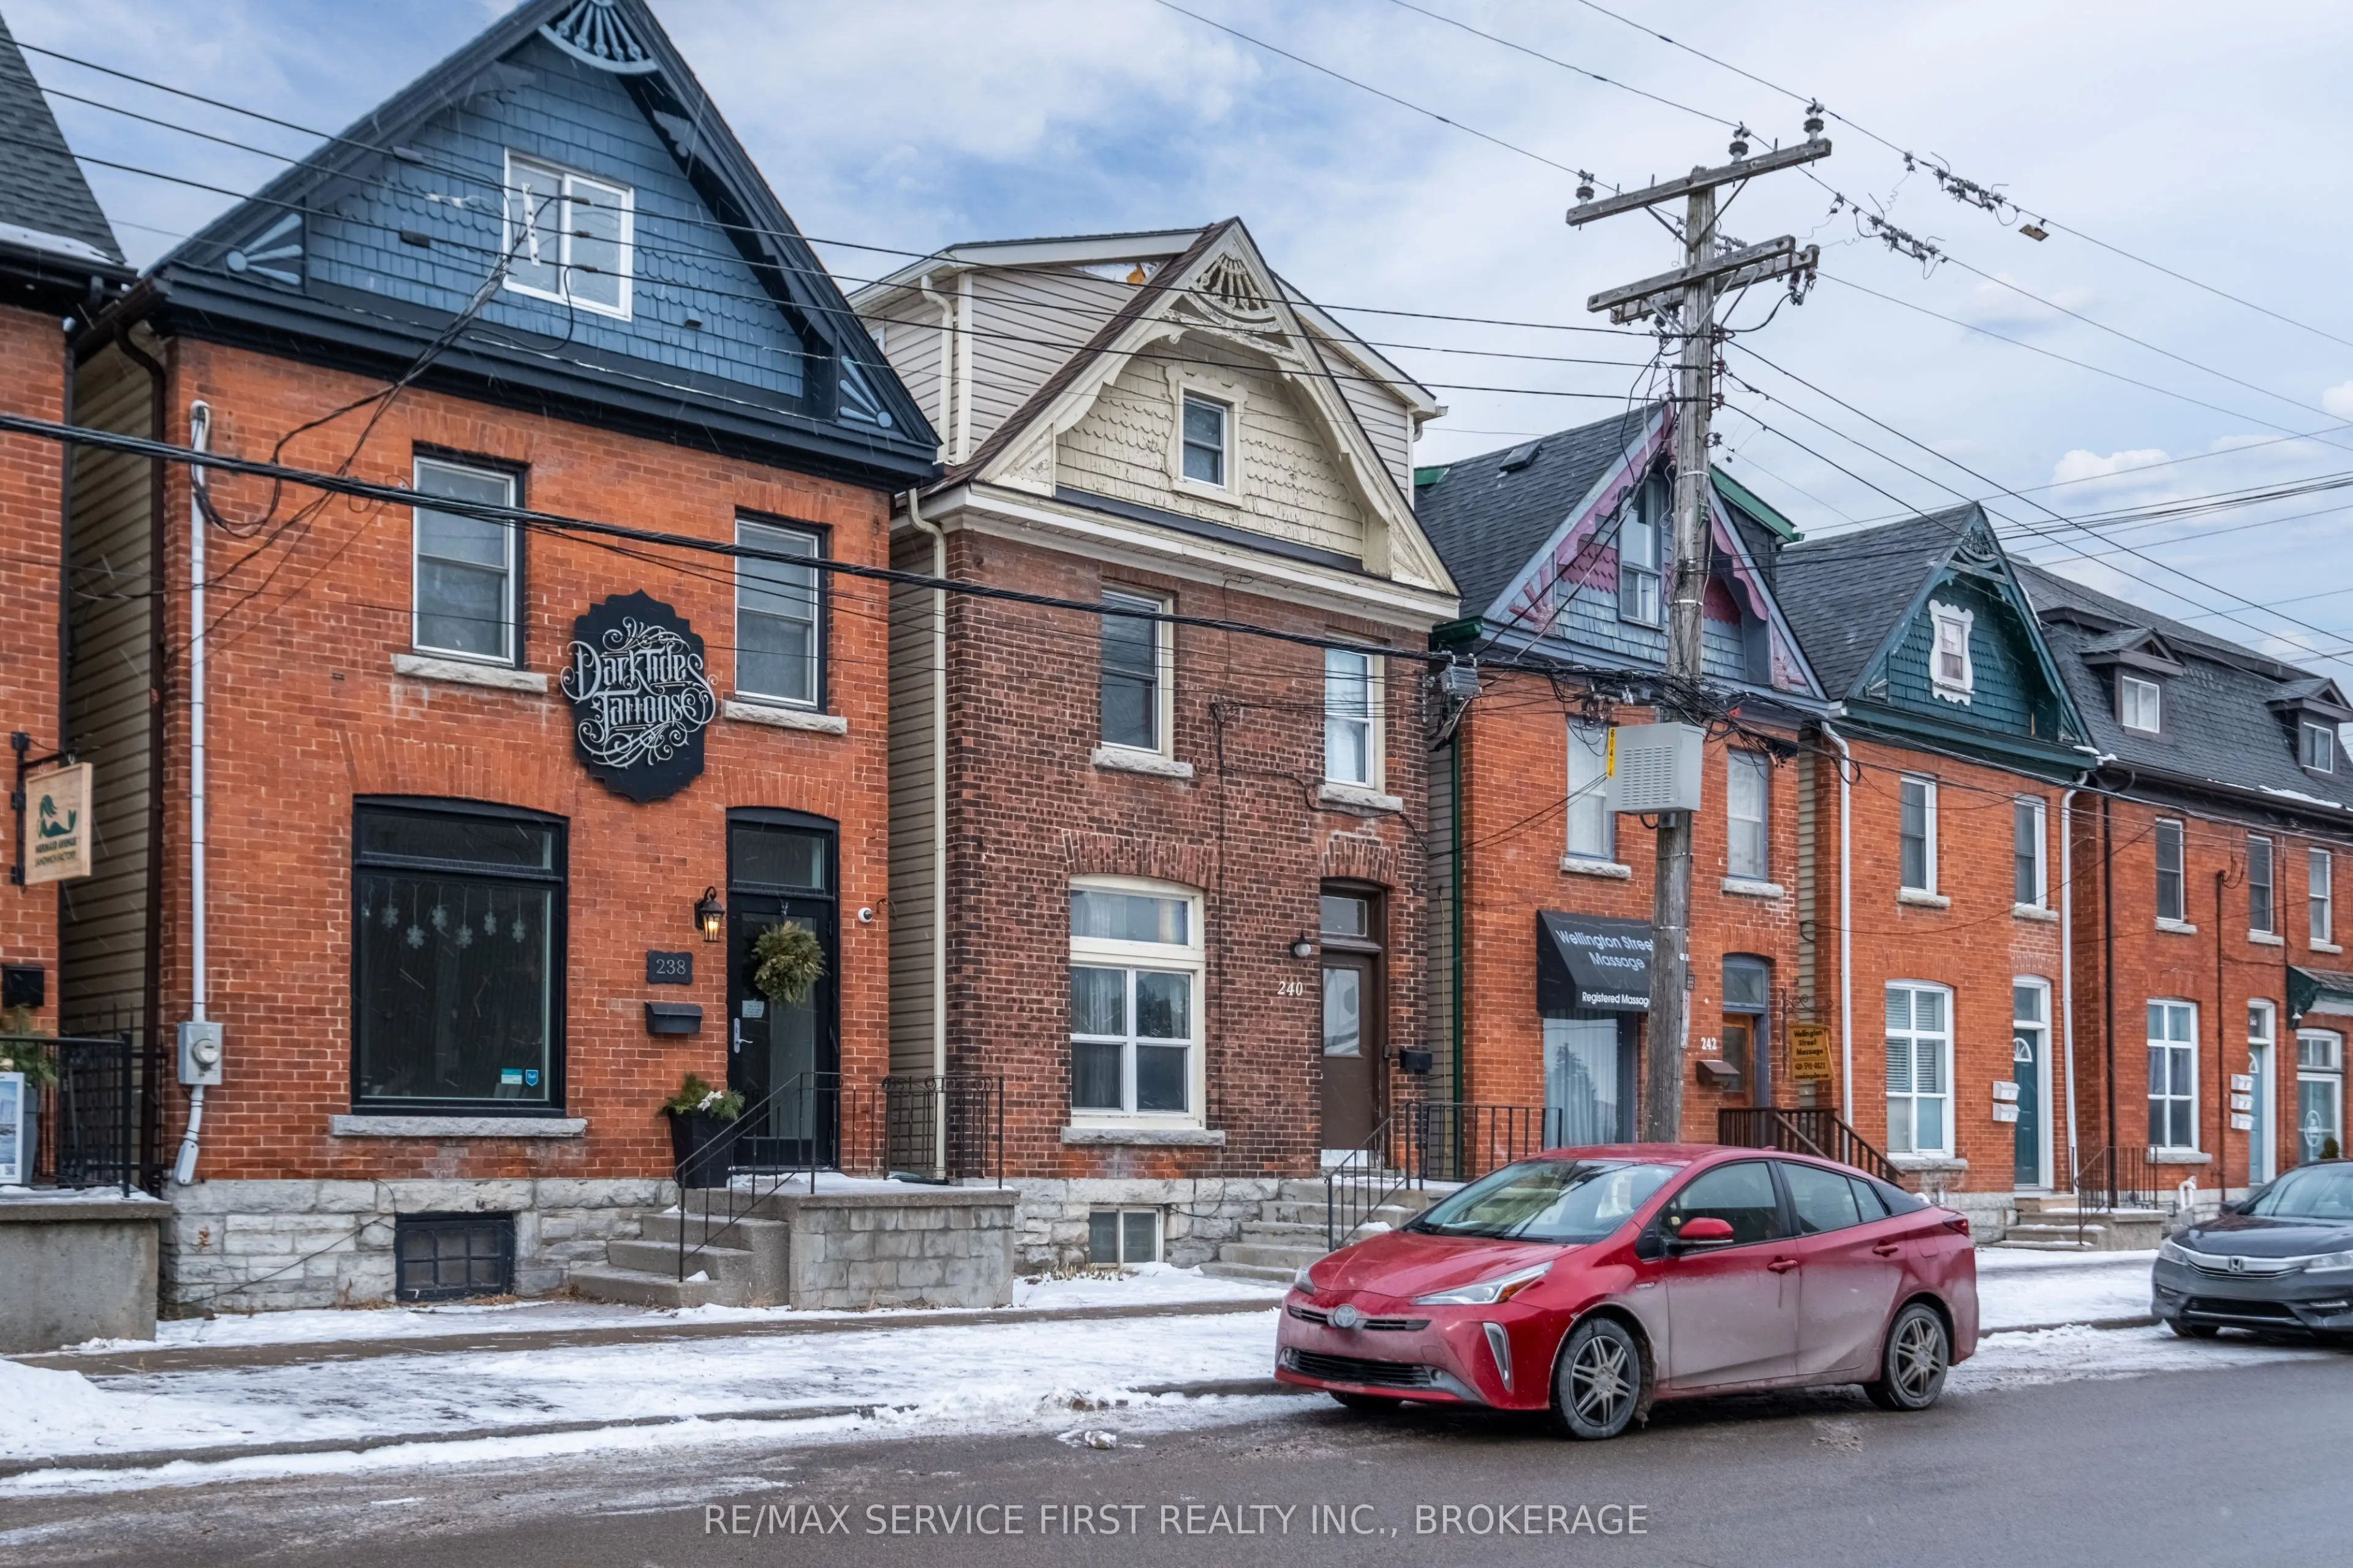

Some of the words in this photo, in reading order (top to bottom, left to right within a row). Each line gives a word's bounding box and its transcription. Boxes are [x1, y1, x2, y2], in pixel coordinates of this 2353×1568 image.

[560, 640, 643, 703] Dark
[591, 687, 688, 733] Tattoos
[1555, 930, 1622, 950] Wellington
[656, 959, 686, 975] 238
[1588, 952, 1645, 971] Massage
[1278, 982, 1303, 996] 240
[1582, 991, 1620, 1005] Registered
[1621, 994, 1650, 1008] Massag
[1700, 1037, 1718, 1050] 242
